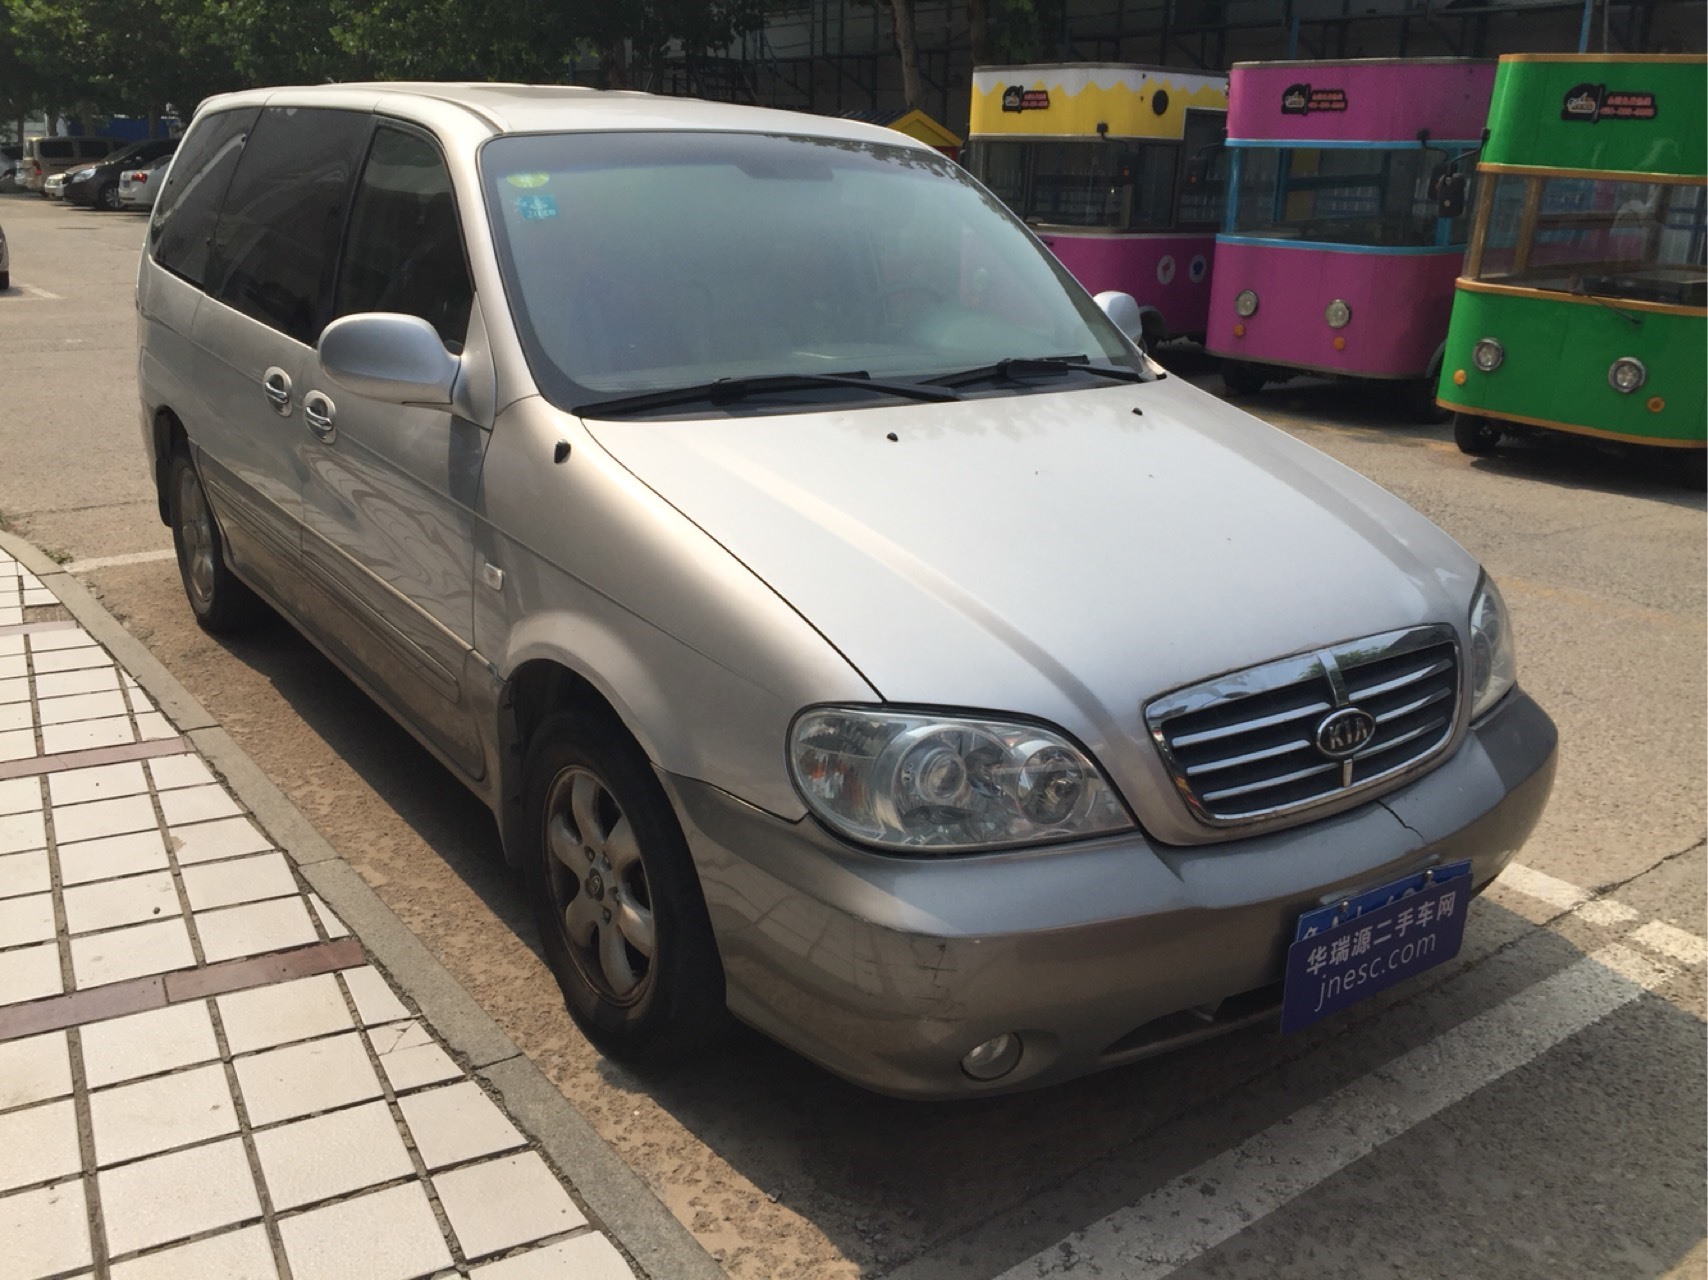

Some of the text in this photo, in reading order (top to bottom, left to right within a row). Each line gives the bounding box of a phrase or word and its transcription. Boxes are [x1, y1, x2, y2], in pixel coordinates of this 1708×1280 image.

[1328, 717, 1368, 749] KIA
[1306, 891, 1456, 975] 华瑞源二手车网
[1314, 933, 1436, 1012] jnesc.com
